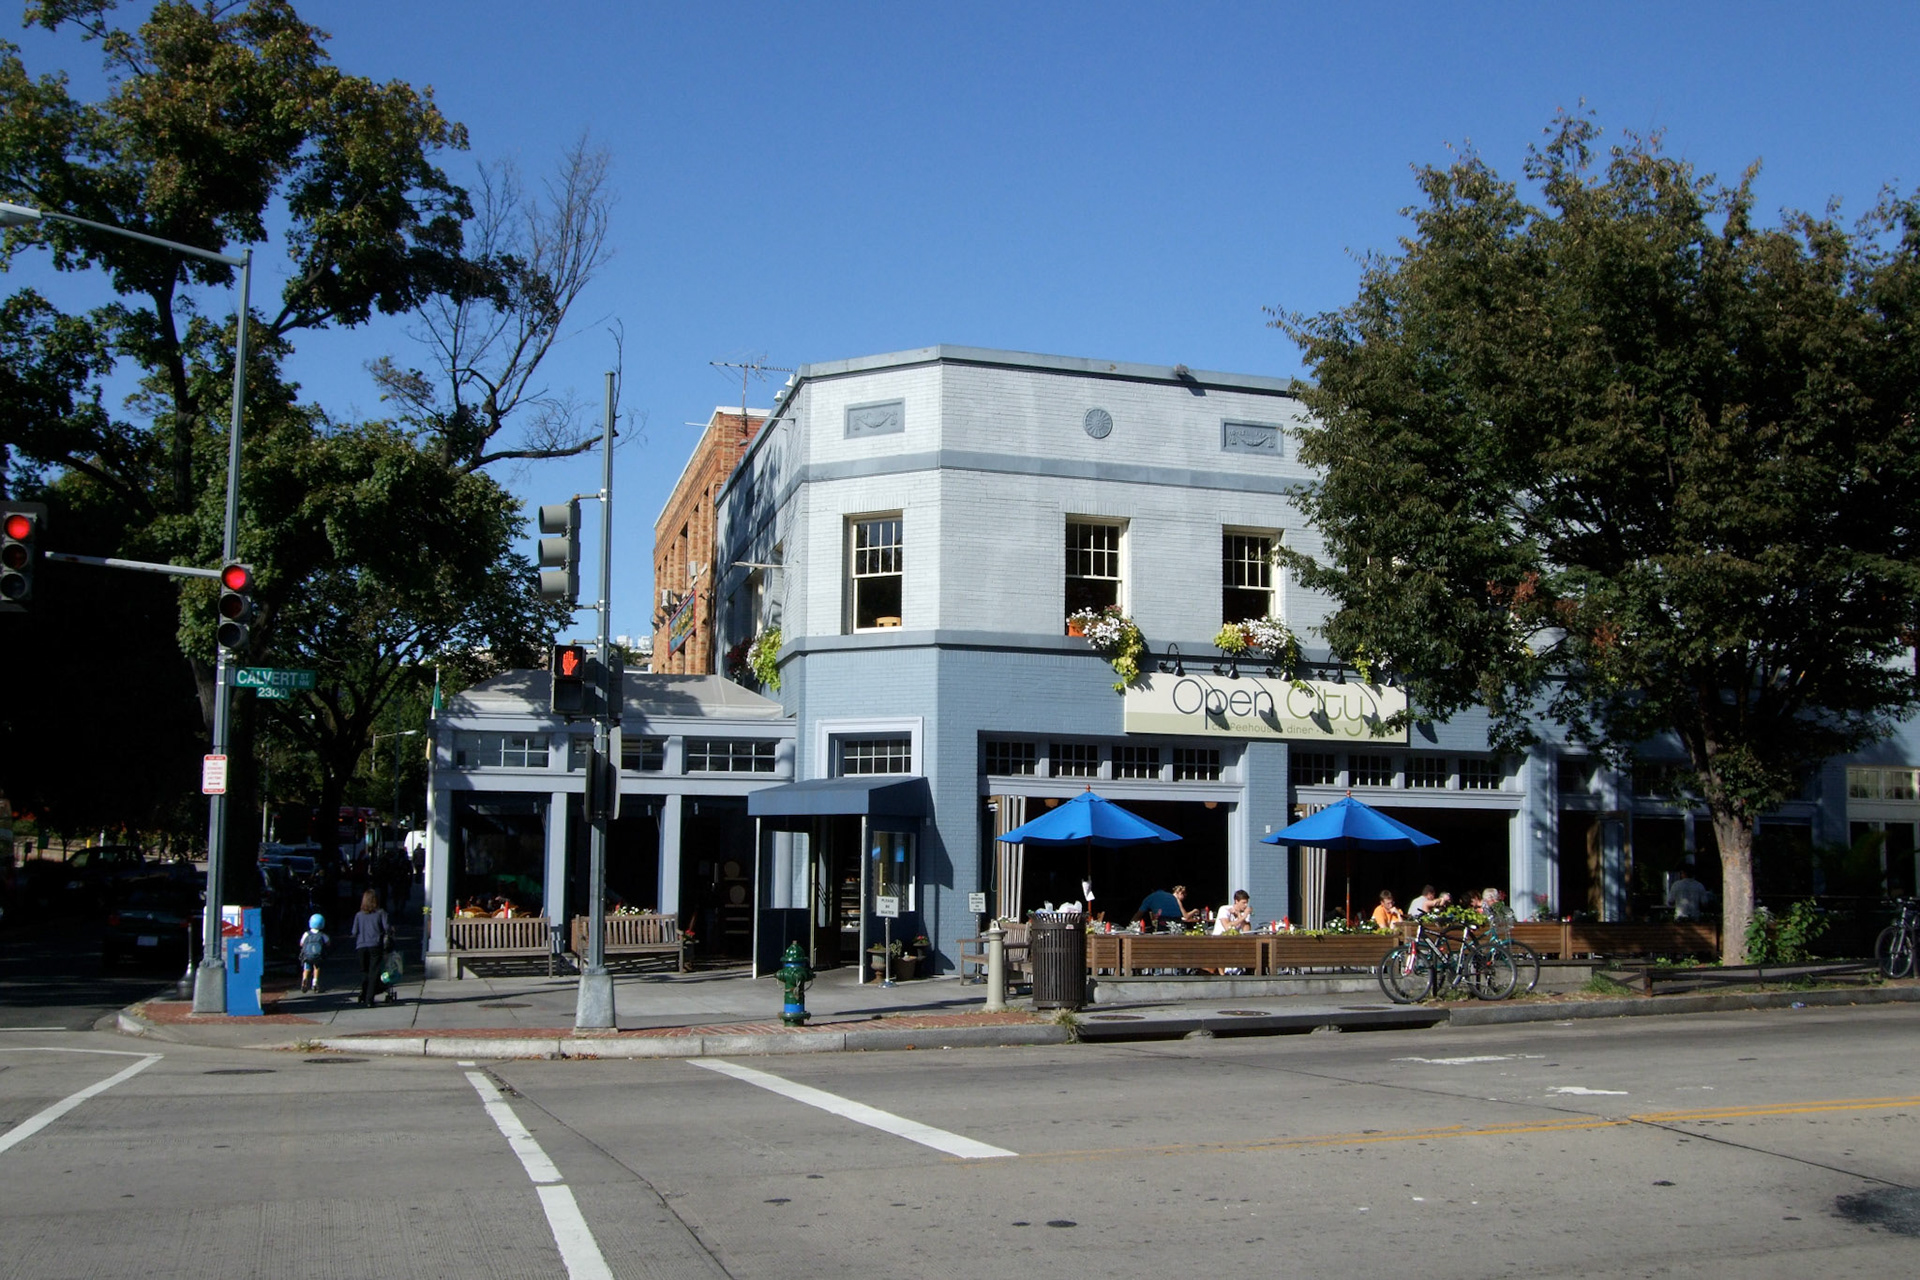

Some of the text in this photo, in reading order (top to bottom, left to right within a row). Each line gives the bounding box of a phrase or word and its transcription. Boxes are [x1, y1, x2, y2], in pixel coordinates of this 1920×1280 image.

[237, 670, 298, 686] CALVERT
[258, 687, 288, 698] 2300
[1173, 678, 1363, 737] Open City
[1211, 722, 1277, 734] cfeehous
[1286, 724, 1314, 735] diner
